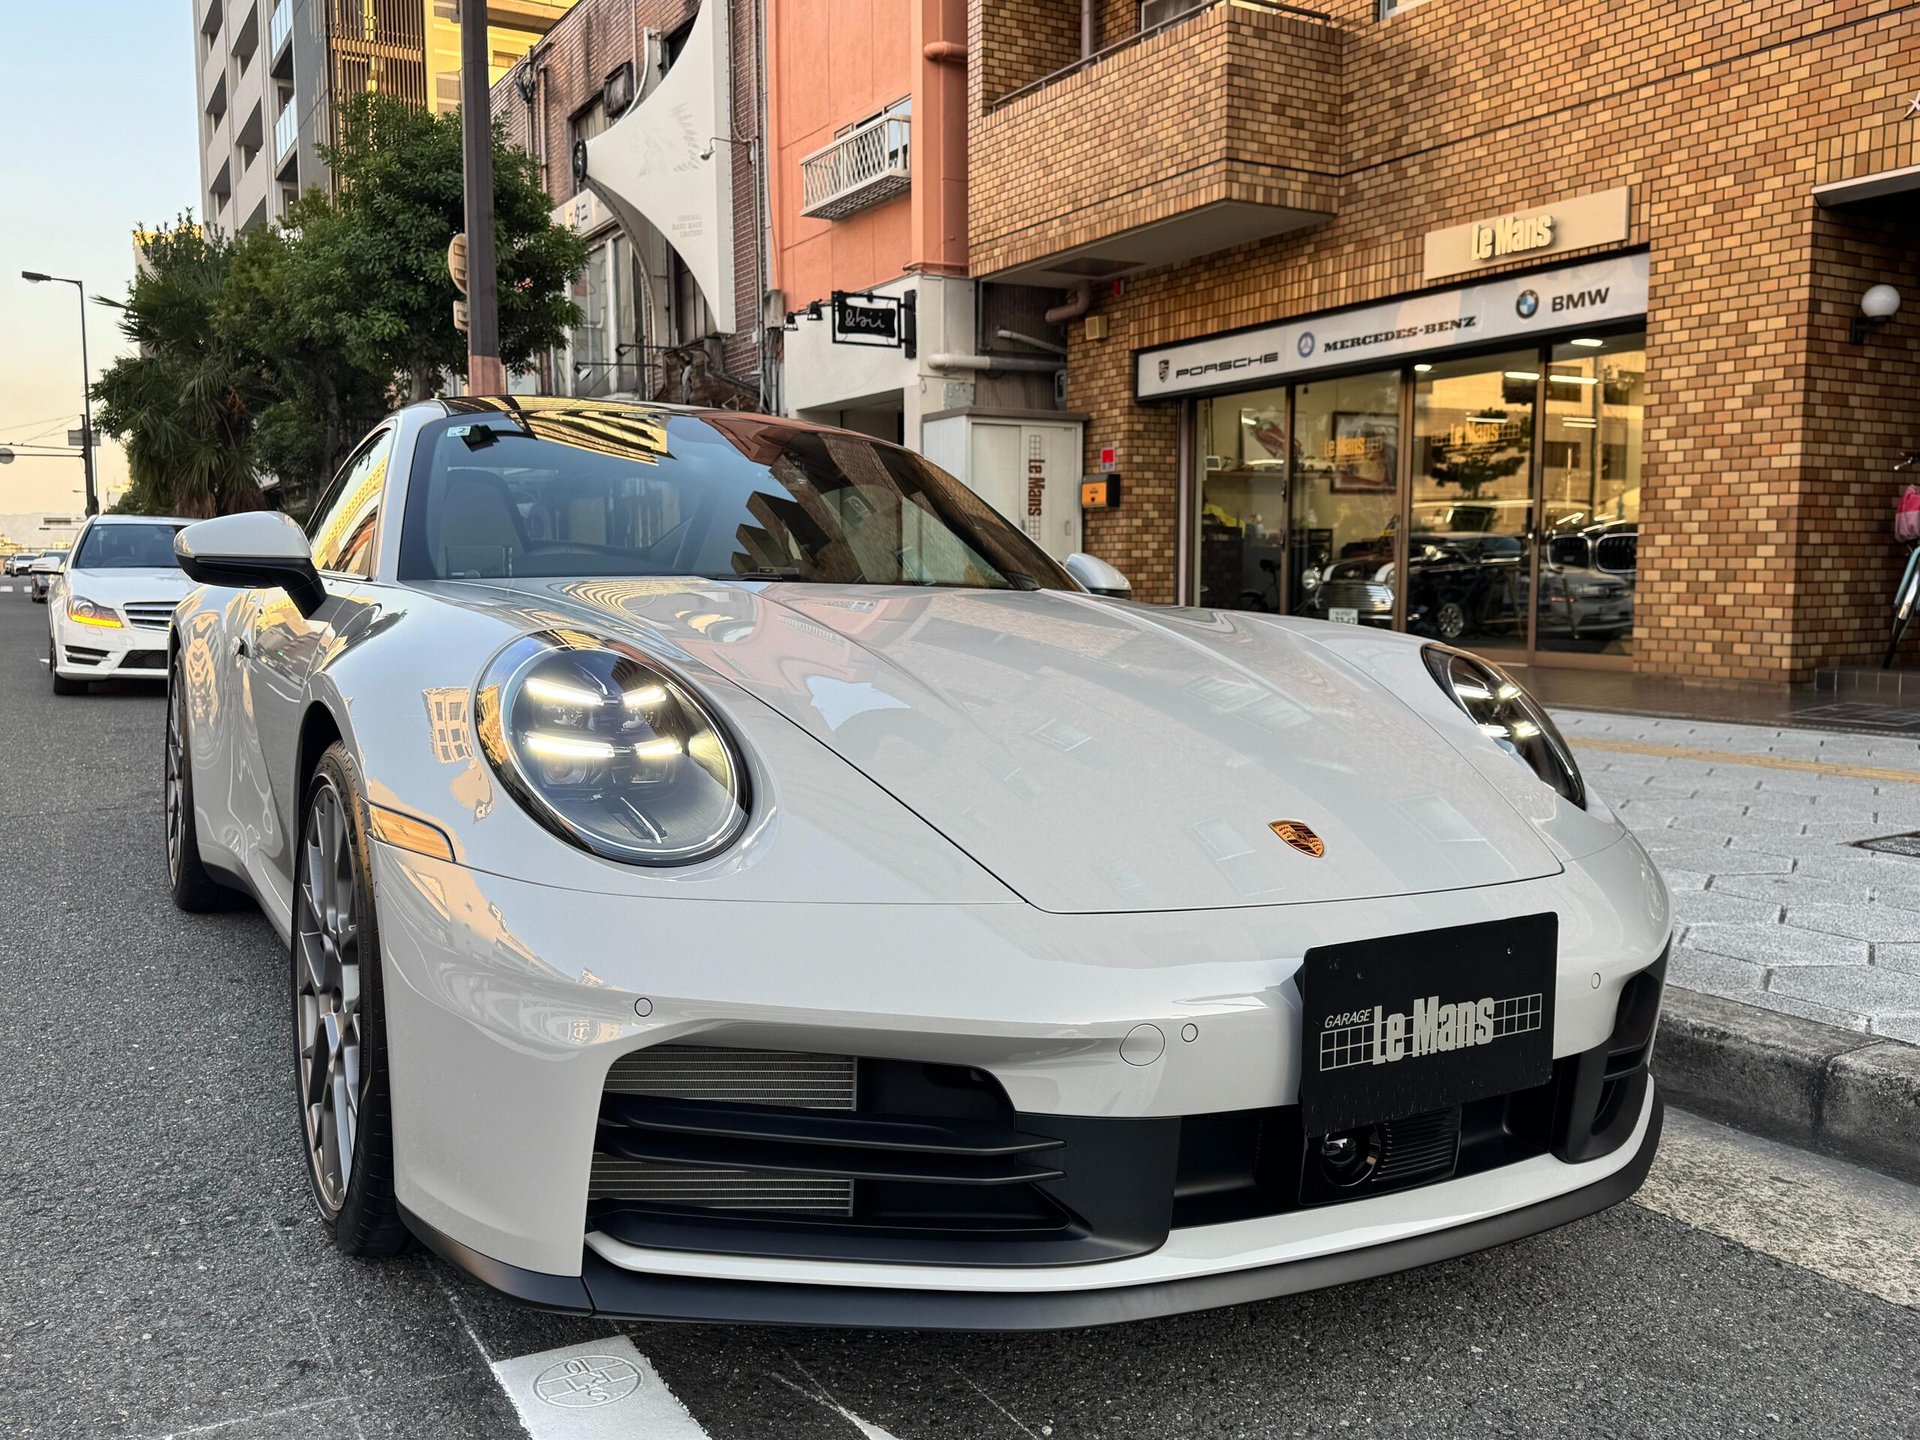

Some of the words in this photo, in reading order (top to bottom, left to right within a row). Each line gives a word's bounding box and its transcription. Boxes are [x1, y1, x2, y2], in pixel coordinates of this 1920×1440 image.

[1471, 224, 1494, 261] Le
[1495, 215, 1553, 256] Mans
[1551, 287, 1609, 312] BMW
[1323, 316, 1476, 352] MERCEDES-BENZ
[1176, 352, 1278, 379] PORSCHE
[1324, 438, 1335, 457] Le
[1336, 435, 1365, 456] Mans
[1450, 423, 1463, 446] Le
[1465, 420, 1499, 444] Mans
[1028, 459, 1045, 474] Le
[1028, 477, 1045, 516] Mans
[1324, 1008, 1372, 1028] GARAGE
[1373, 1005, 1405, 1065] Le
[1412, 996, 1494, 1057] Mans
